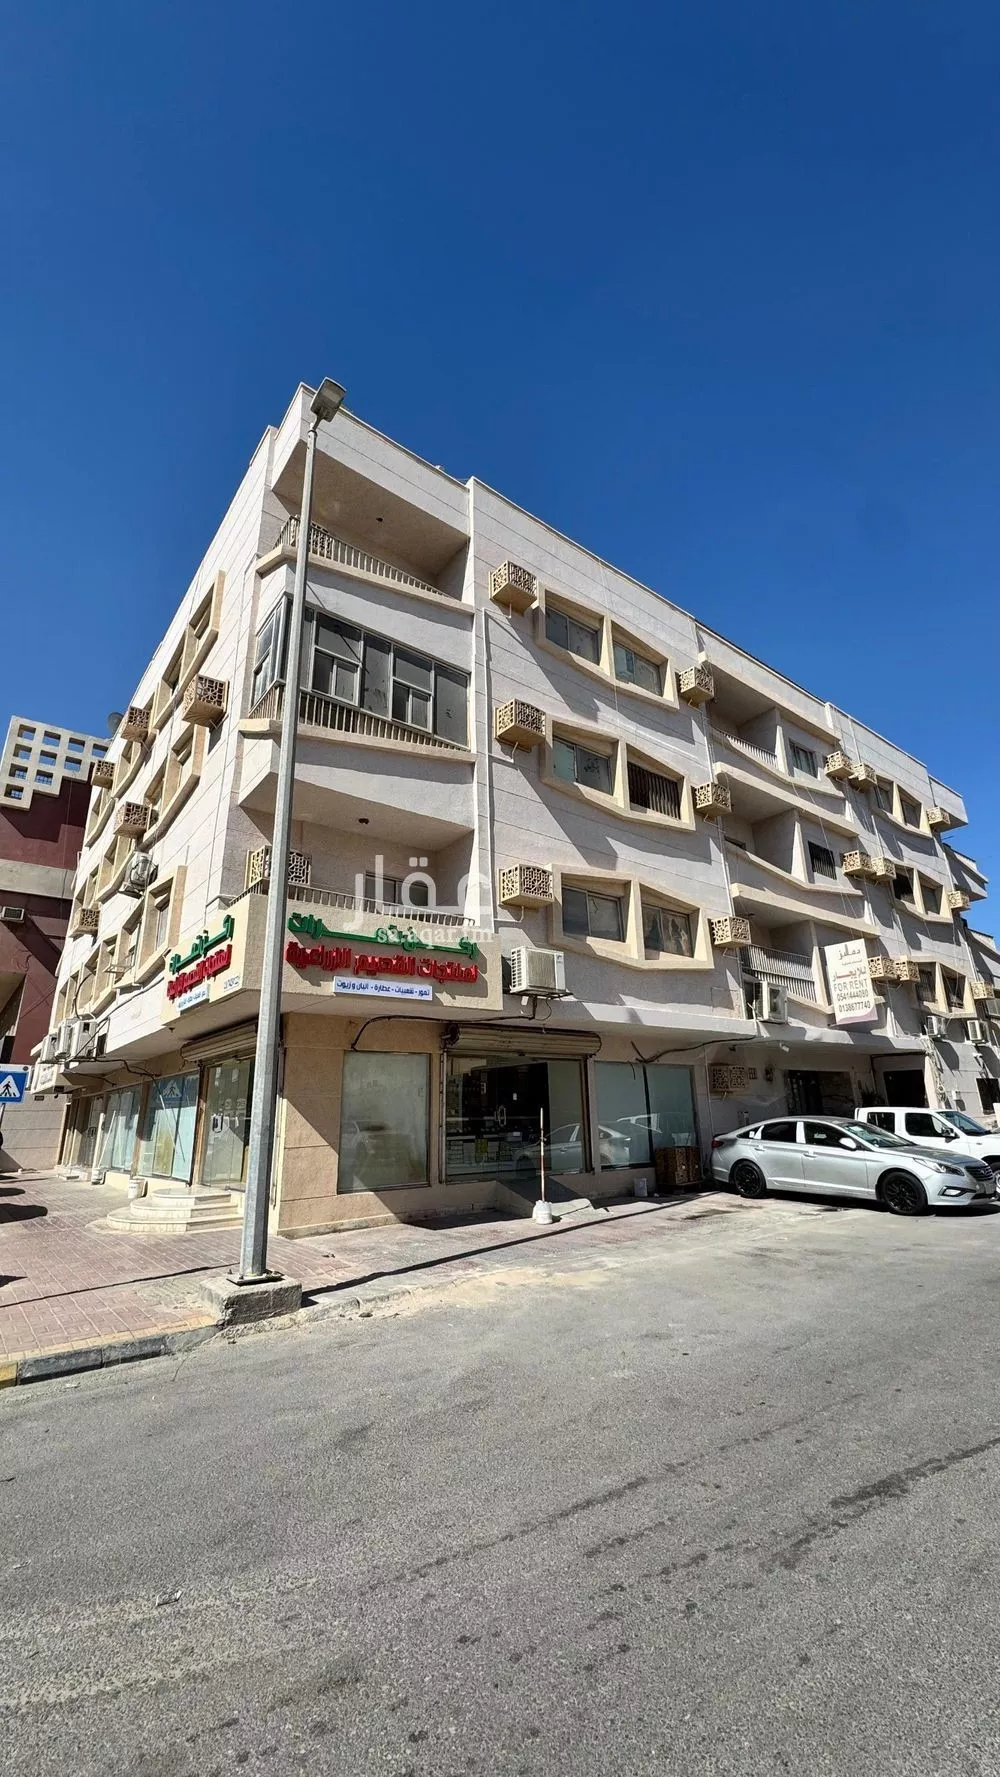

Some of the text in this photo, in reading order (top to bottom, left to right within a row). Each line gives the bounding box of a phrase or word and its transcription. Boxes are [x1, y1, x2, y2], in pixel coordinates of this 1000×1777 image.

[286, 941, 479, 984] لمنتجات القصيم الزراعية
[834, 978, 868, 992] FOR RENT
